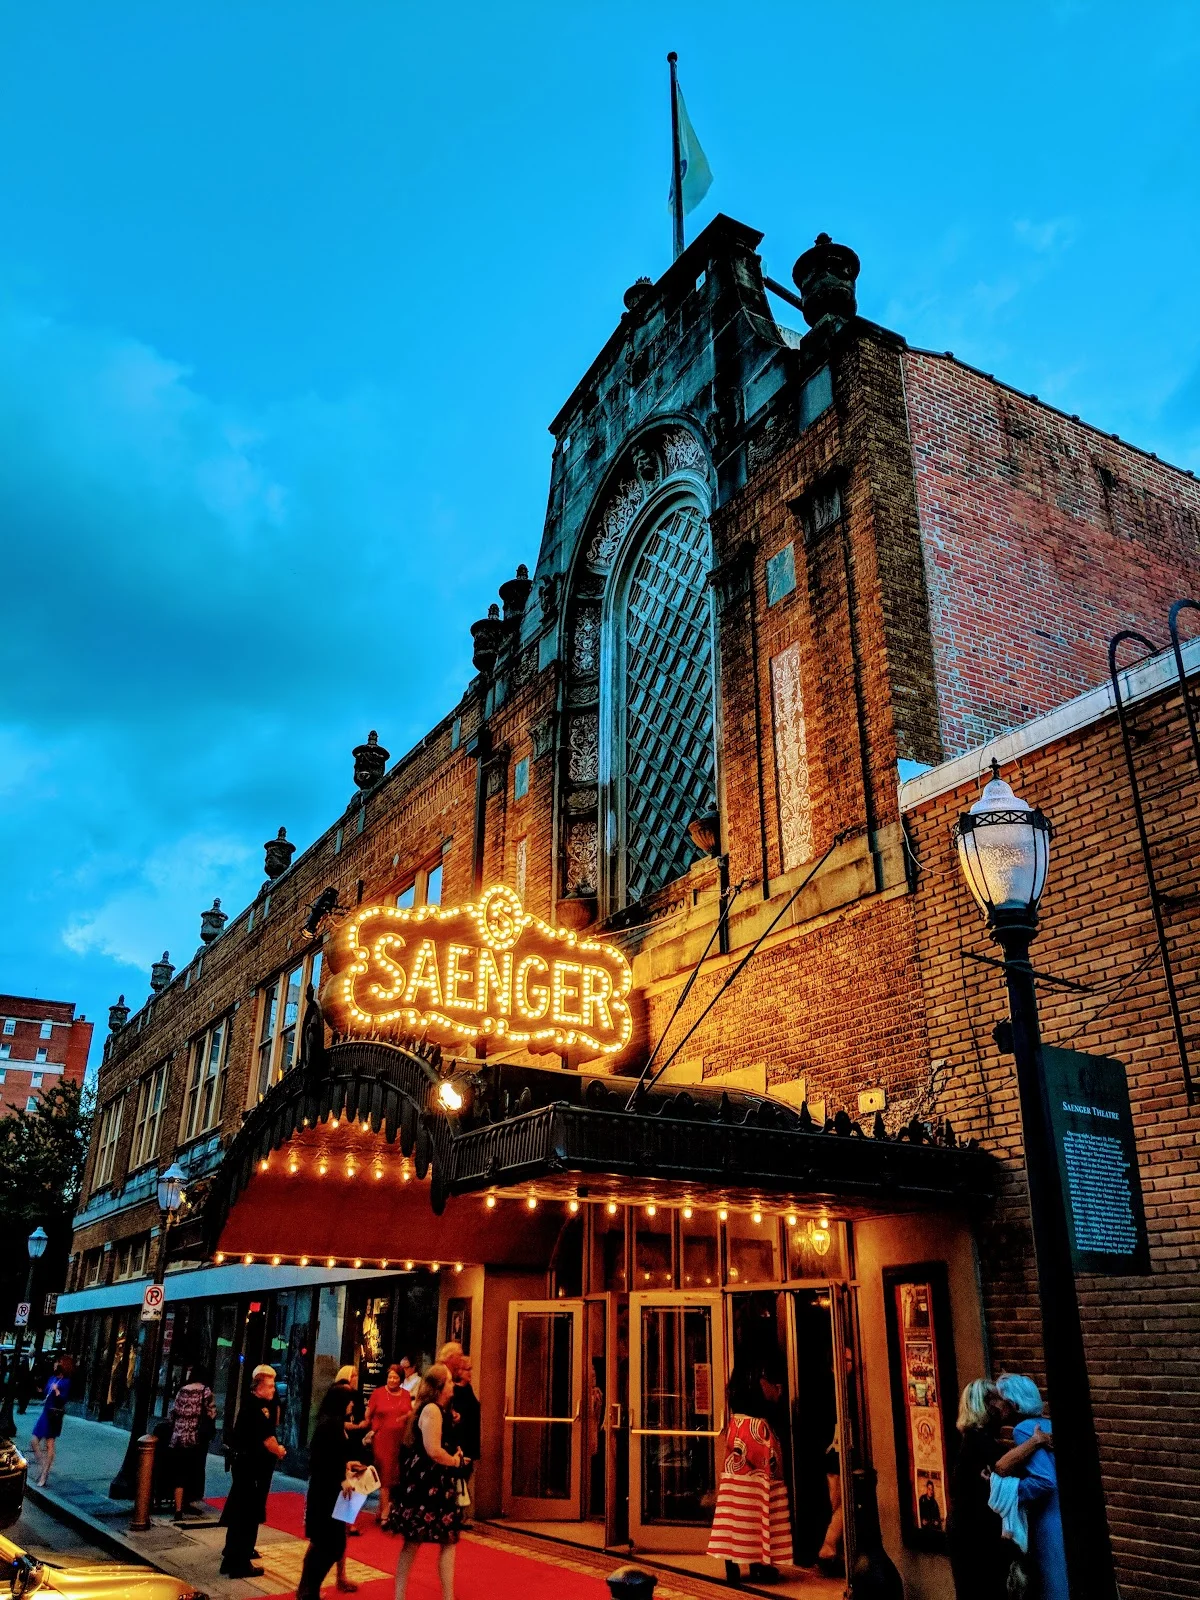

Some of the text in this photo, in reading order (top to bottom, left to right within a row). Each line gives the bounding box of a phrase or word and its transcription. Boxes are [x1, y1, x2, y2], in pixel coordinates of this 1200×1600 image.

[370, 932, 615, 1030] SAENGER
[1062, 1101, 1120, 1120] SAENGER THEATRE
